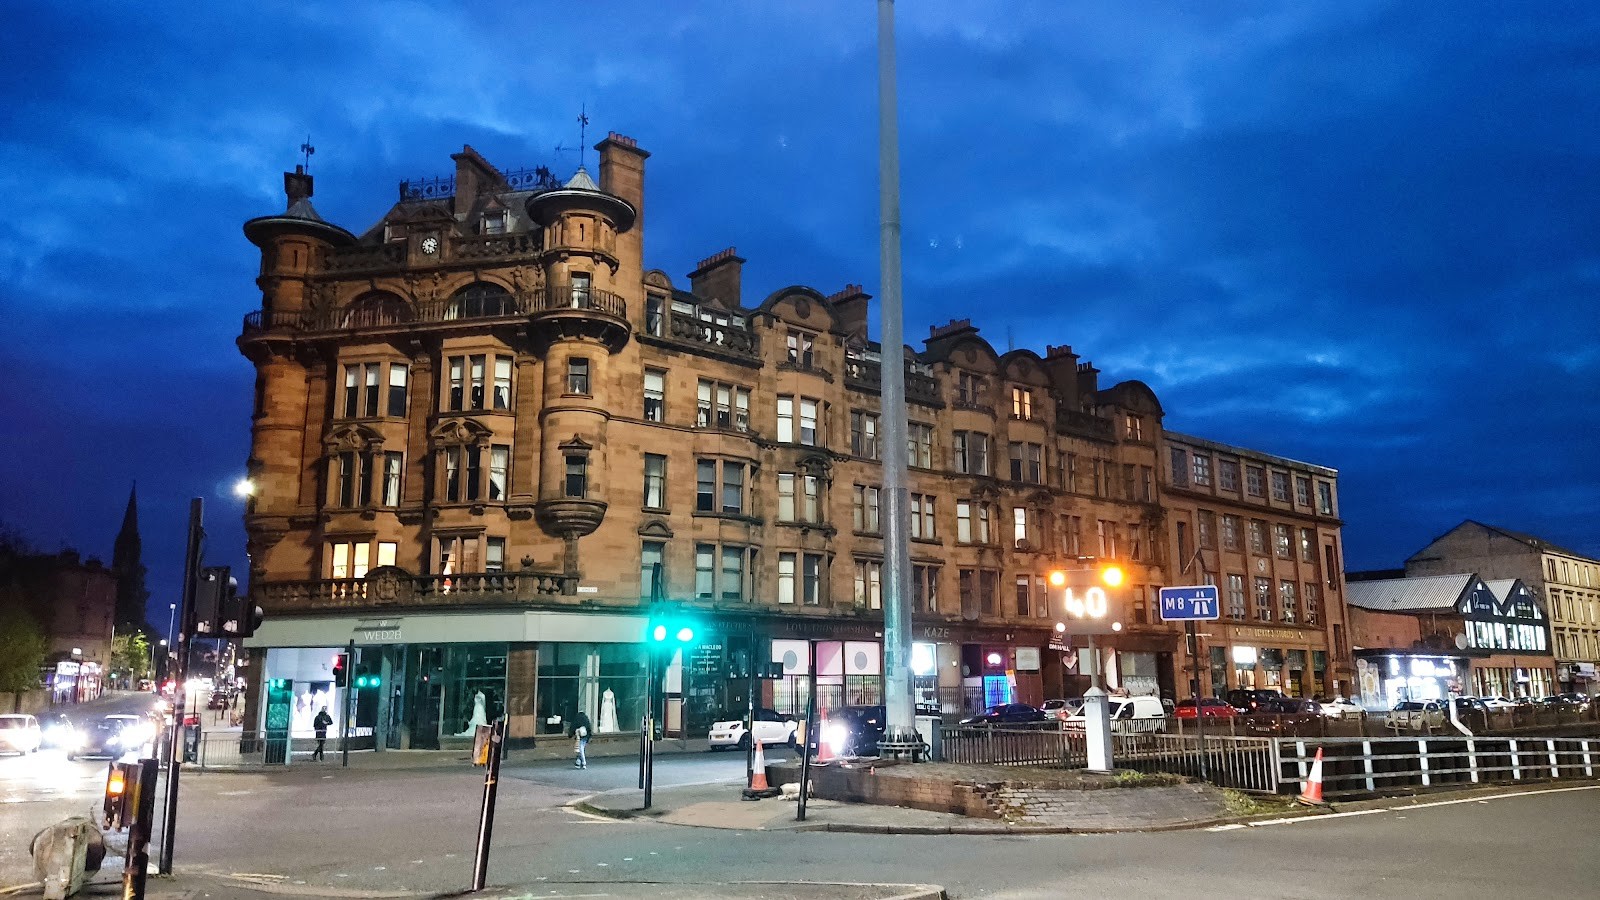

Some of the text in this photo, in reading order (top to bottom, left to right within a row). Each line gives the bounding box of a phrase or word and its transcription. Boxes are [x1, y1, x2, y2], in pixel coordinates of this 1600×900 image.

[1065, 586, 1107, 619] 40
[364, 630, 402, 640] WED2B
[923, 627, 950, 638] KAZE
